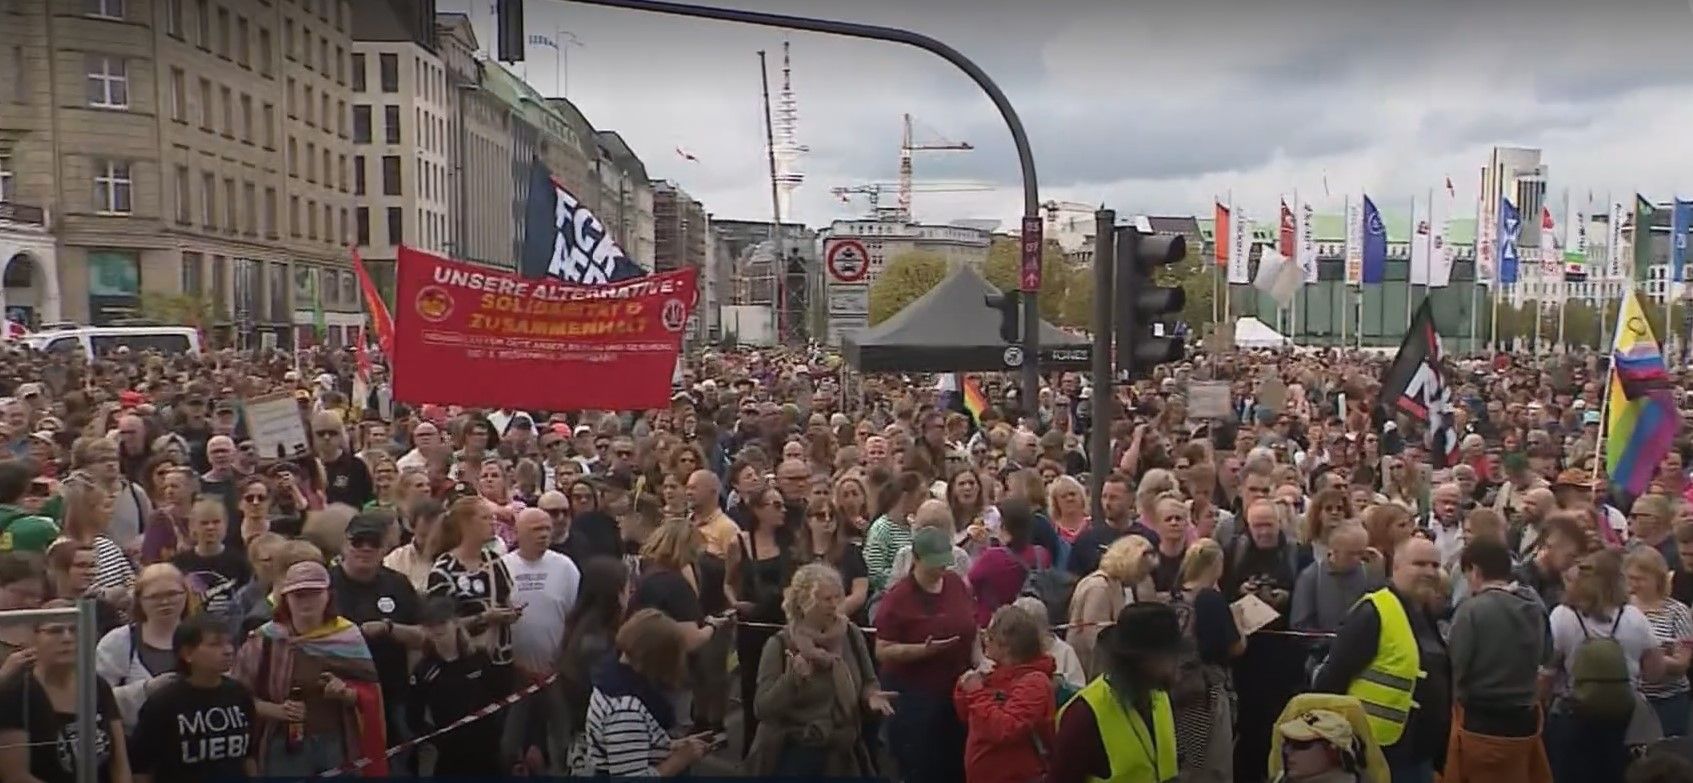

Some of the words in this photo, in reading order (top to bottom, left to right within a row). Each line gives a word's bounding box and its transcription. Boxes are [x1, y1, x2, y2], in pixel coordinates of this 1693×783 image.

[555, 187, 624, 279] FCK
[434, 266, 529, 298] UNSERE
[467, 313, 645, 335] ZUSAMMENHALT
